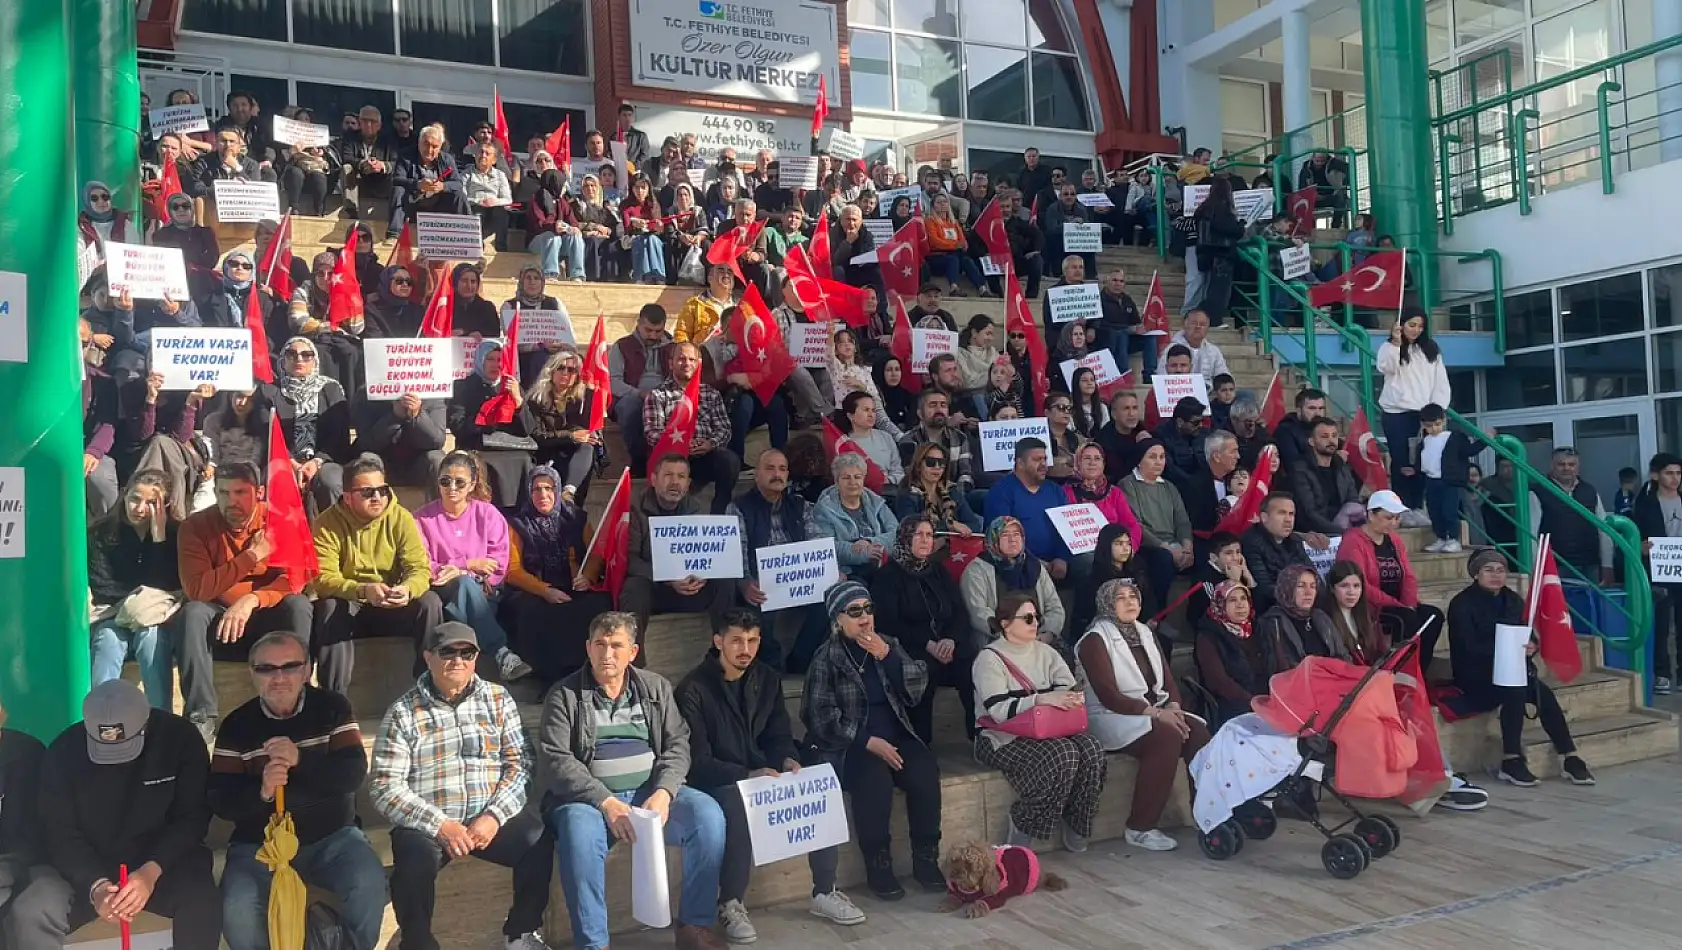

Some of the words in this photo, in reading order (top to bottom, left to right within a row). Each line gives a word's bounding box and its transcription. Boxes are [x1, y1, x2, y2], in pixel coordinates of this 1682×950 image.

[663, 17, 686, 29] T.C.
[734, 41, 794, 66] Olgun
[736, 63, 821, 90] MERKEZ
[702, 116, 731, 131] 444
[734, 119, 752, 132] 90
[757, 121, 775, 134] 82
[156, 335, 204, 348] TURİZM
[210, 338, 248, 350] VARSA
[386, 342, 434, 354] TURİZMLE
[172, 352, 234, 365] EKONOMİ
[388, 357, 432, 368] BÜYÜYEN
[190, 370, 220, 381] VAR!
[369, 383, 400, 396] GÜÇLÜ
[404, 383, 451, 392] YARINLAR!
[982, 425, 1016, 439] TURİZM
[1020, 426, 1046, 436] VARSA
[654, 524, 698, 538] TURİZM
[702, 526, 738, 536] VARSA
[670, 540, 726, 554] EKONOMİ
[684, 558, 712, 570] VAR!
[760, 552, 801, 570] TURİZM
[804, 548, 835, 563] VARSA
[776, 563, 825, 584] EKONOMİ
[790, 584, 815, 598] VAR!
[748, 784, 795, 808] TURİZM
[798, 776, 838, 796] VARSA
[768, 795, 827, 826] EKONOMİ
[787, 824, 816, 844] VAR!
